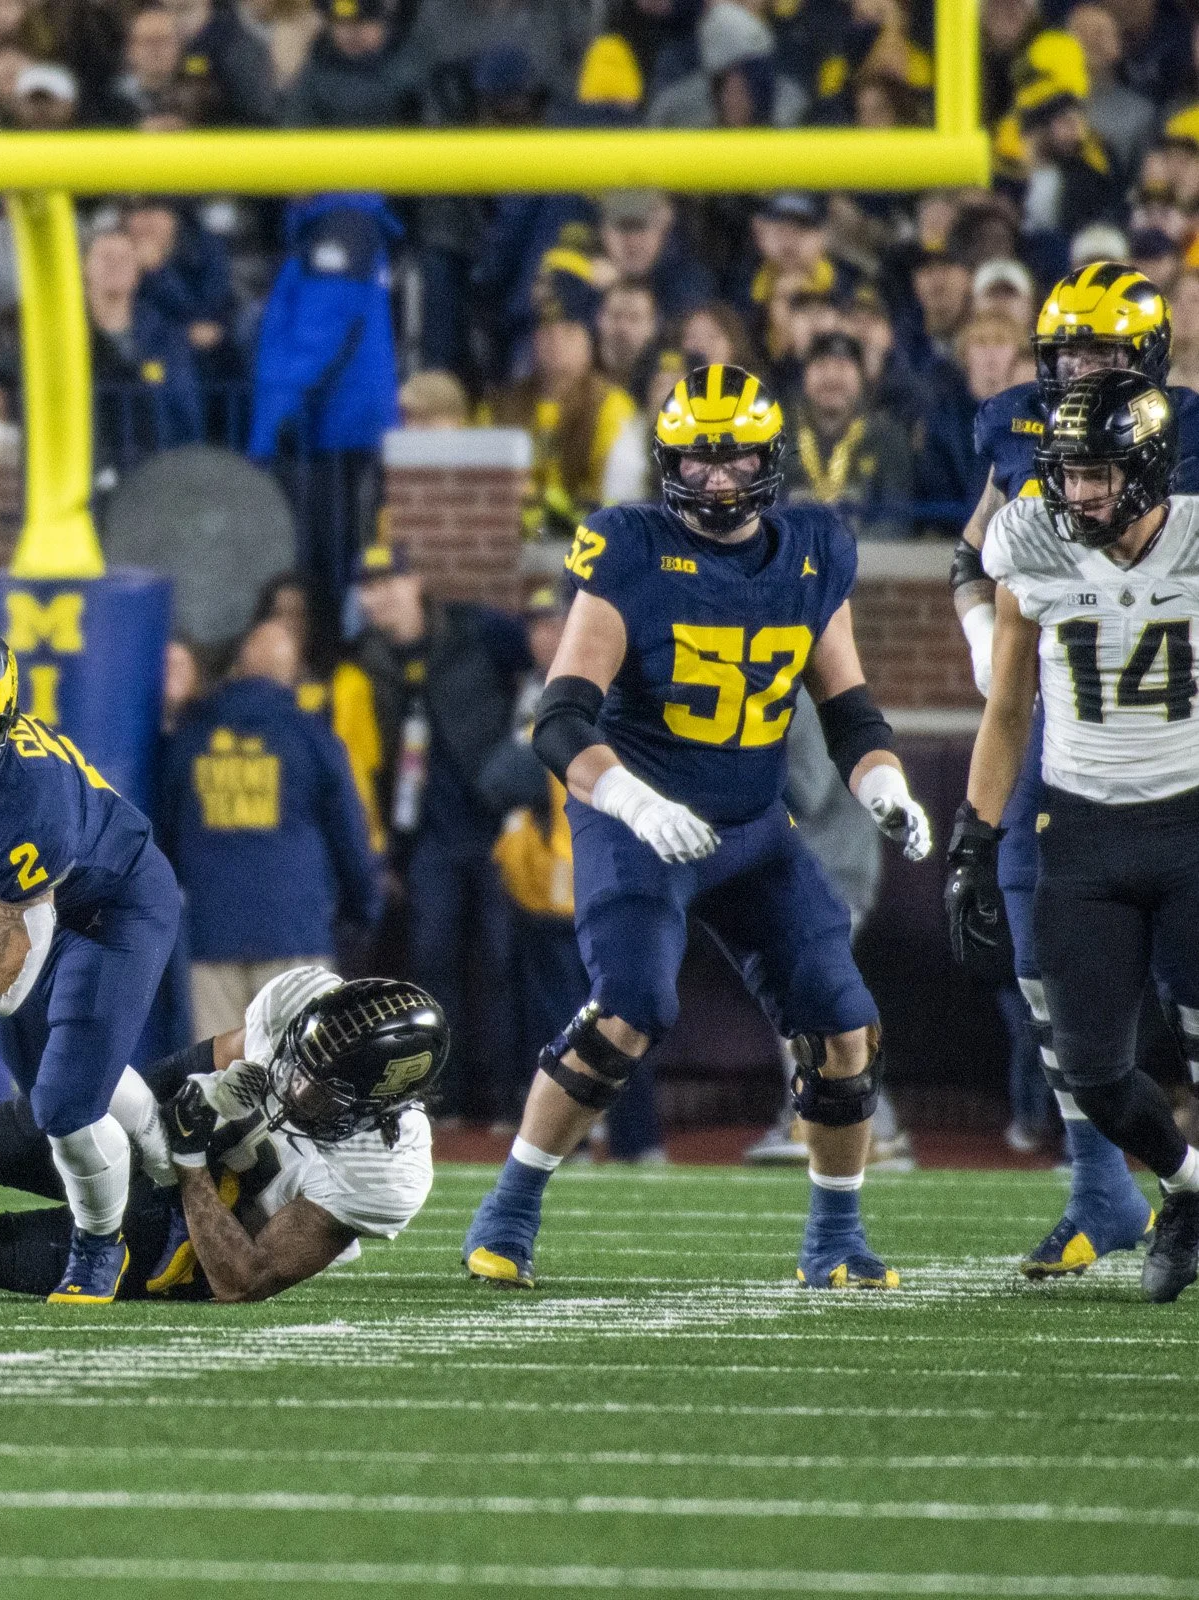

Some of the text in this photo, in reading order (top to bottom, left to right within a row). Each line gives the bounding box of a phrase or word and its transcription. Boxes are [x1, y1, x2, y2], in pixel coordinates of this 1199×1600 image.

[564, 524, 606, 580] 52
[663, 623, 813, 747] 52
[1057, 619, 1198, 725] 14
[9, 842, 49, 891] 2
[369, 1051, 432, 1096] P
